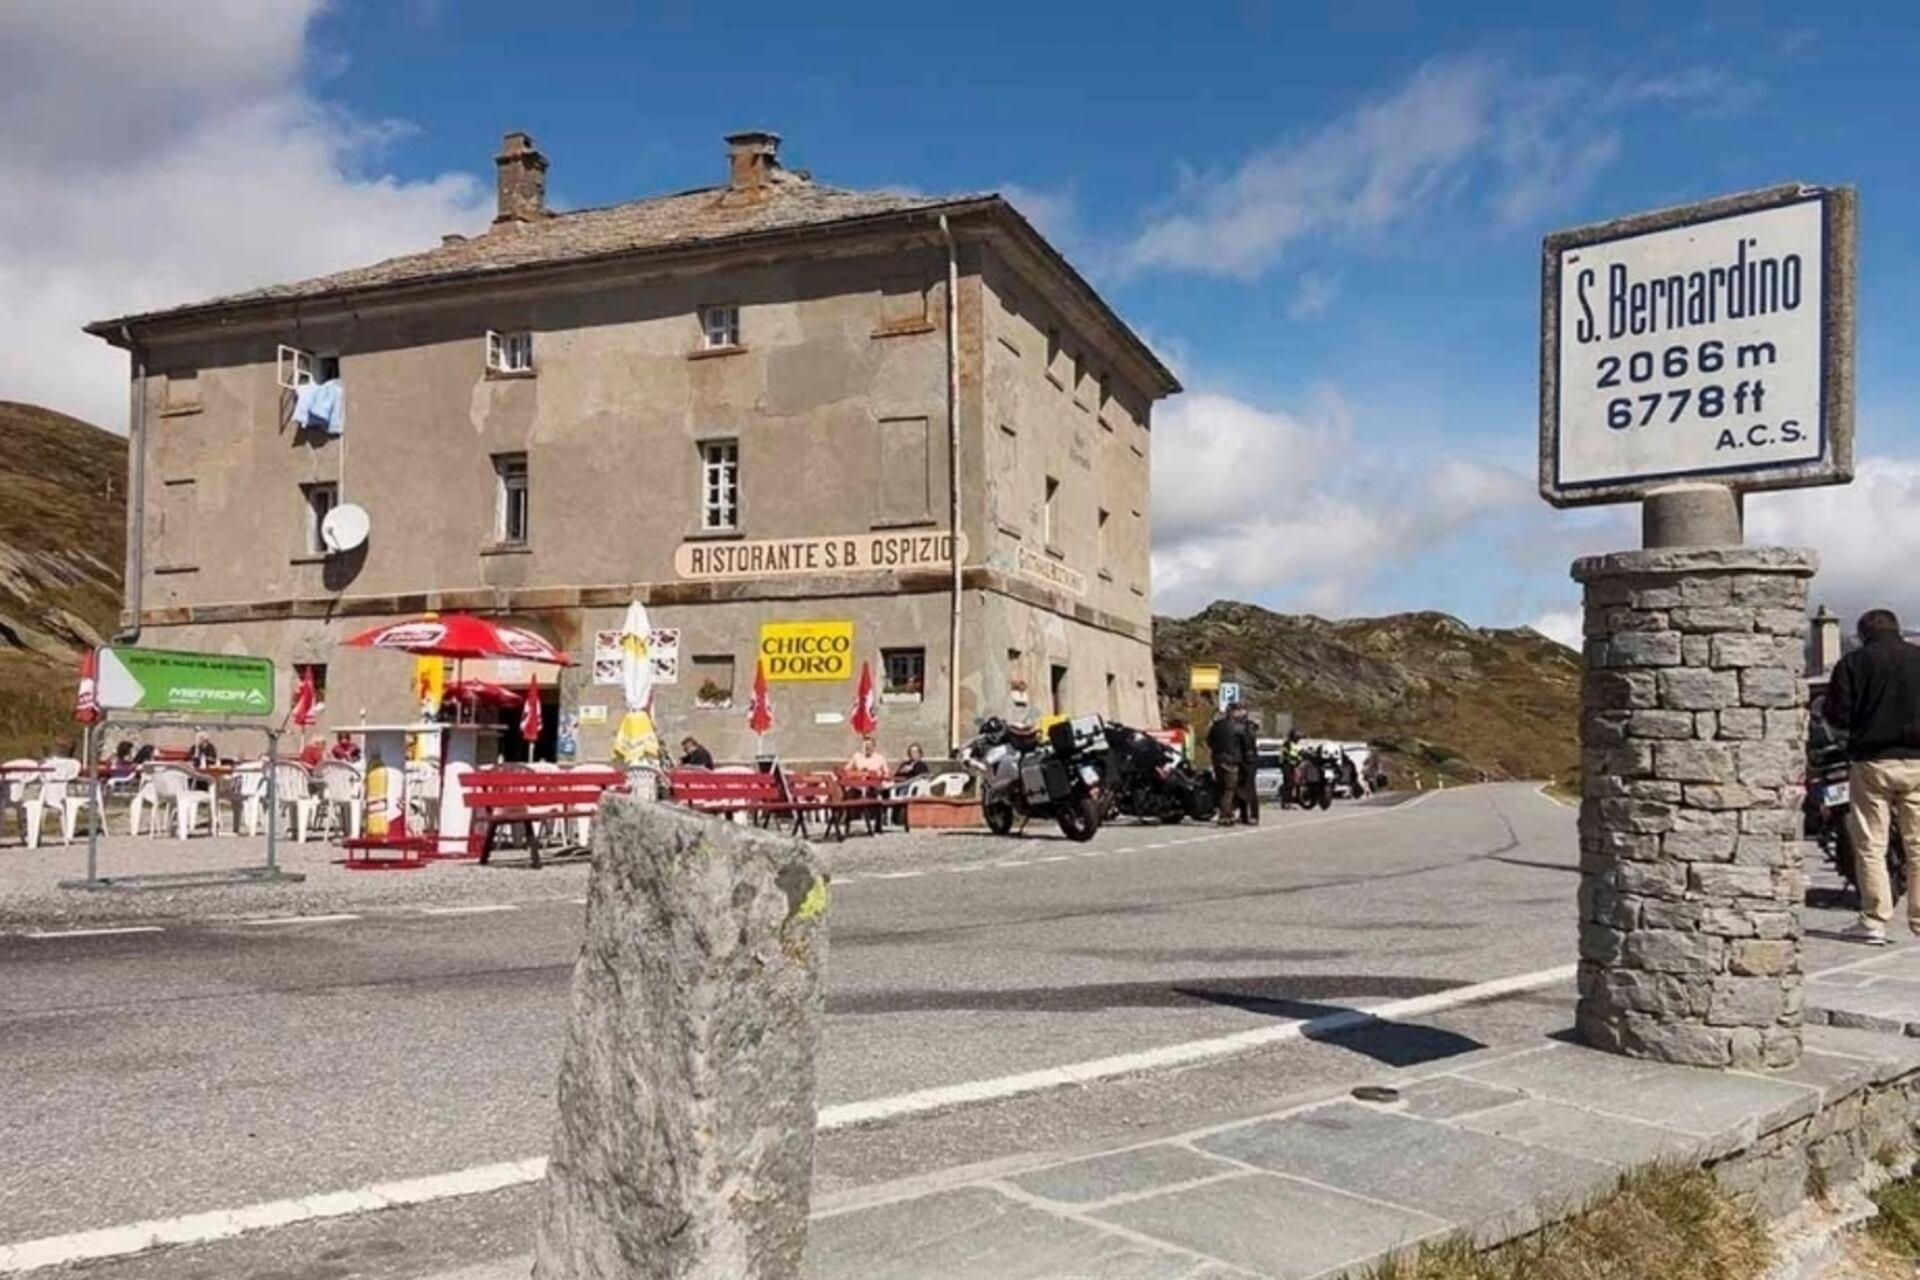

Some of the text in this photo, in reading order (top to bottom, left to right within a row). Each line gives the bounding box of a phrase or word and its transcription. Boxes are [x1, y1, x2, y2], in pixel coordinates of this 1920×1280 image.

[1609, 238, 1802, 341] Bernardino
[690, 542, 819, 573] RISTORANTE
[870, 535, 955, 565] OSPIZIO
[762, 635, 850, 655] CHICCO
[769, 654, 843, 675] D'ORO
[1224, 686, 1234, 701] P
